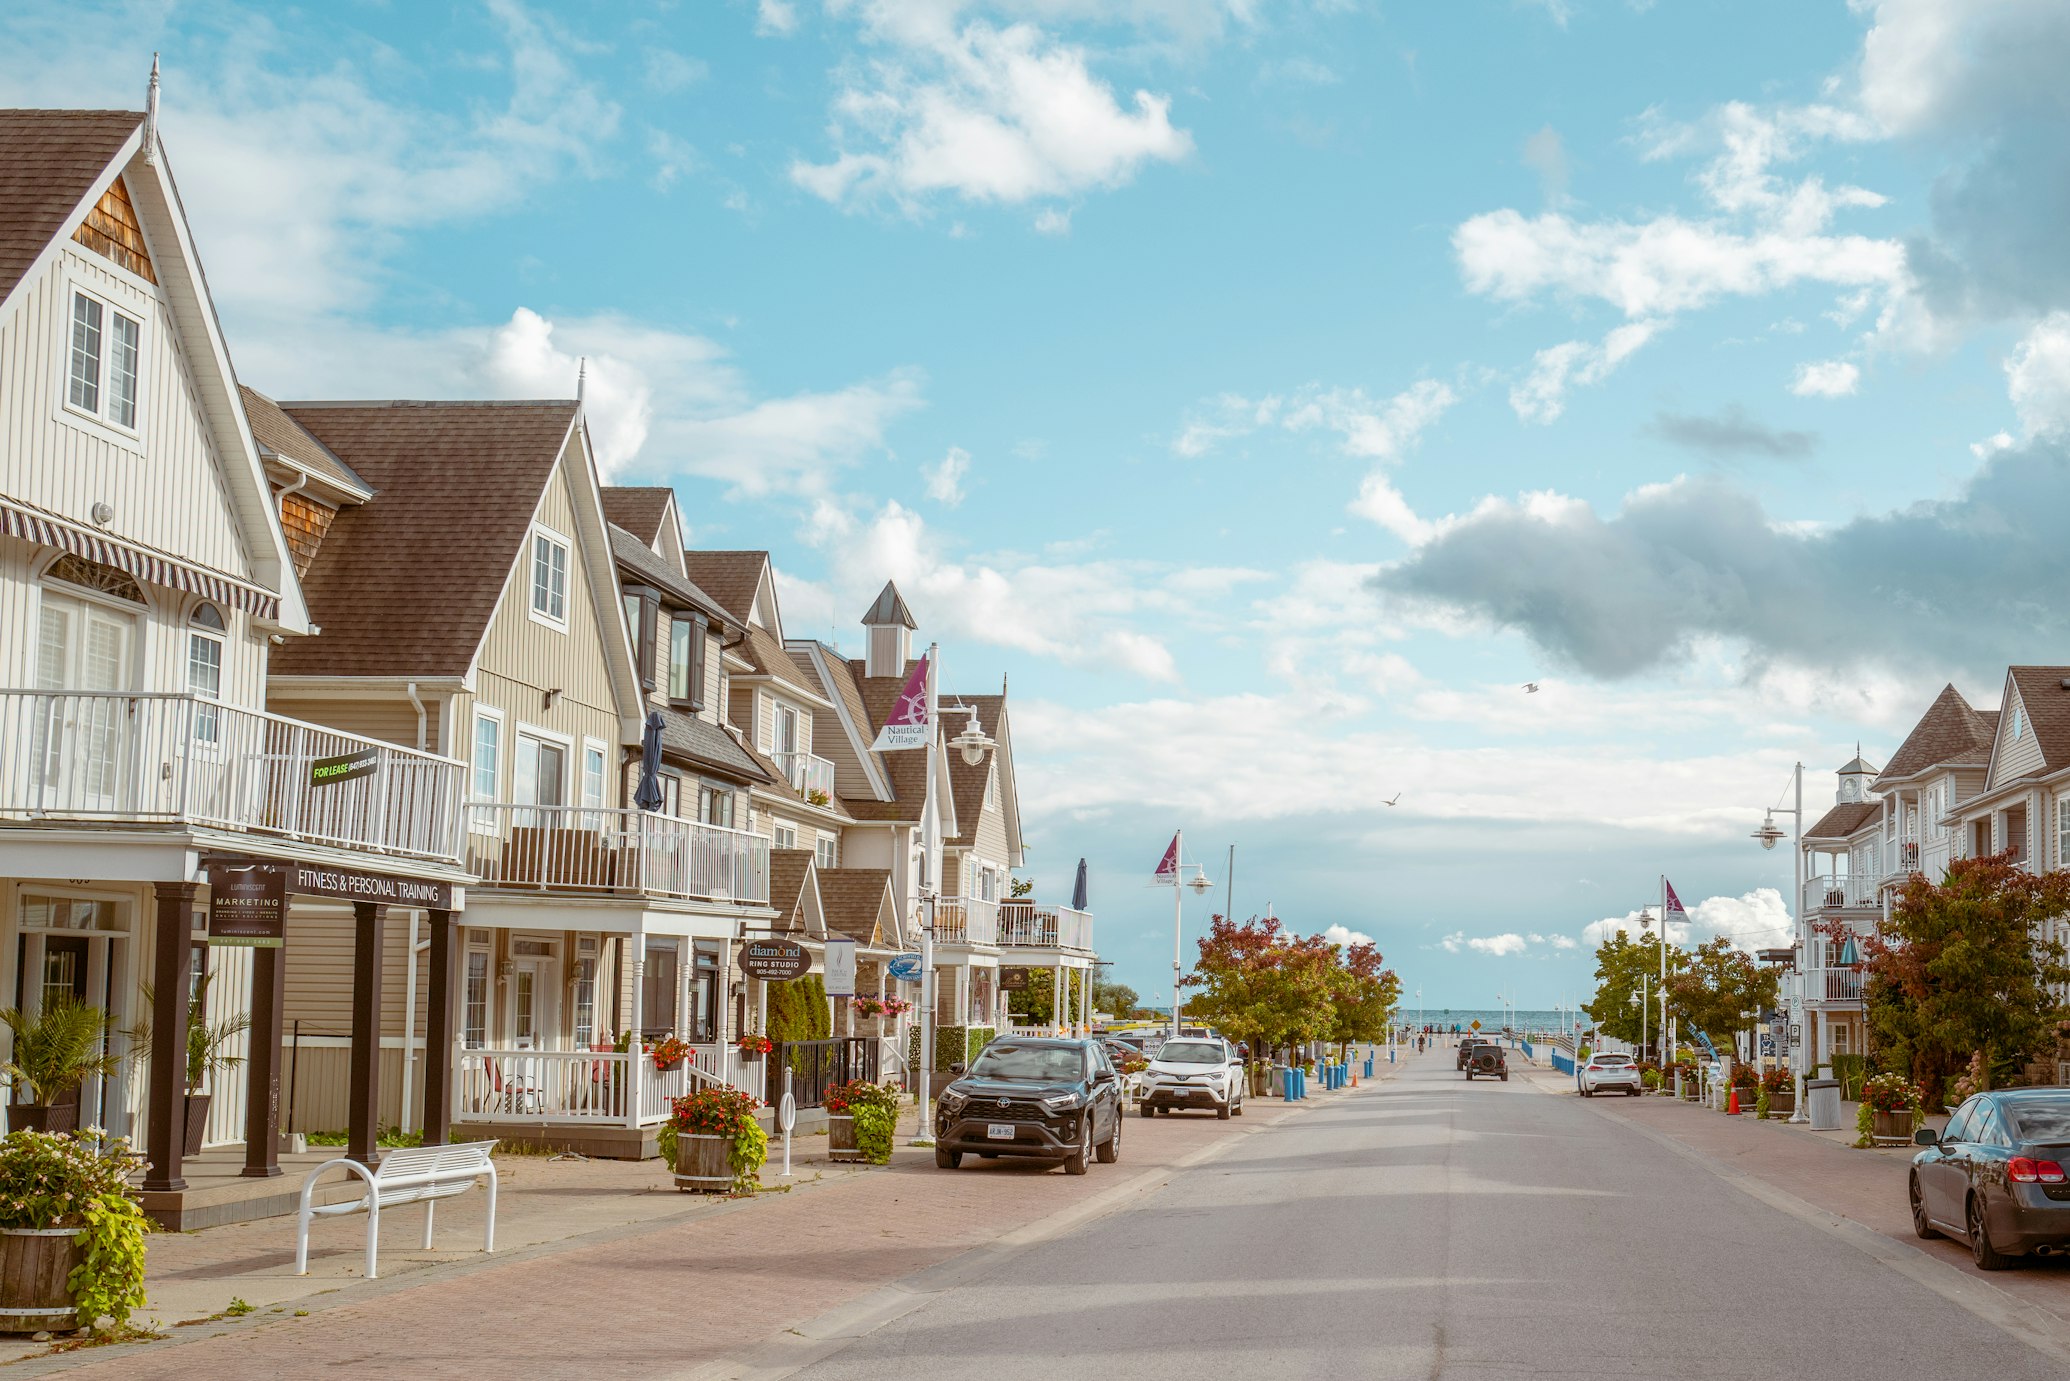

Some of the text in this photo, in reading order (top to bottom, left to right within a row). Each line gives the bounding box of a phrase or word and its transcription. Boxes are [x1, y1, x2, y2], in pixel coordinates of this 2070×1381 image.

[888, 725, 925, 735] Nautical
[888, 735, 919, 745] Village
[313, 767, 329, 779] FOR
[329, 763, 349, 776] LEASE
[298, 869, 338, 891] FITNESS
[339, 874, 347, 892] &
[348, 876, 397, 897] PERSONAL
[397, 881, 439, 902] TRAINING
[216, 897, 279, 907] MARKETING
[749, 944, 801, 957] diamond
